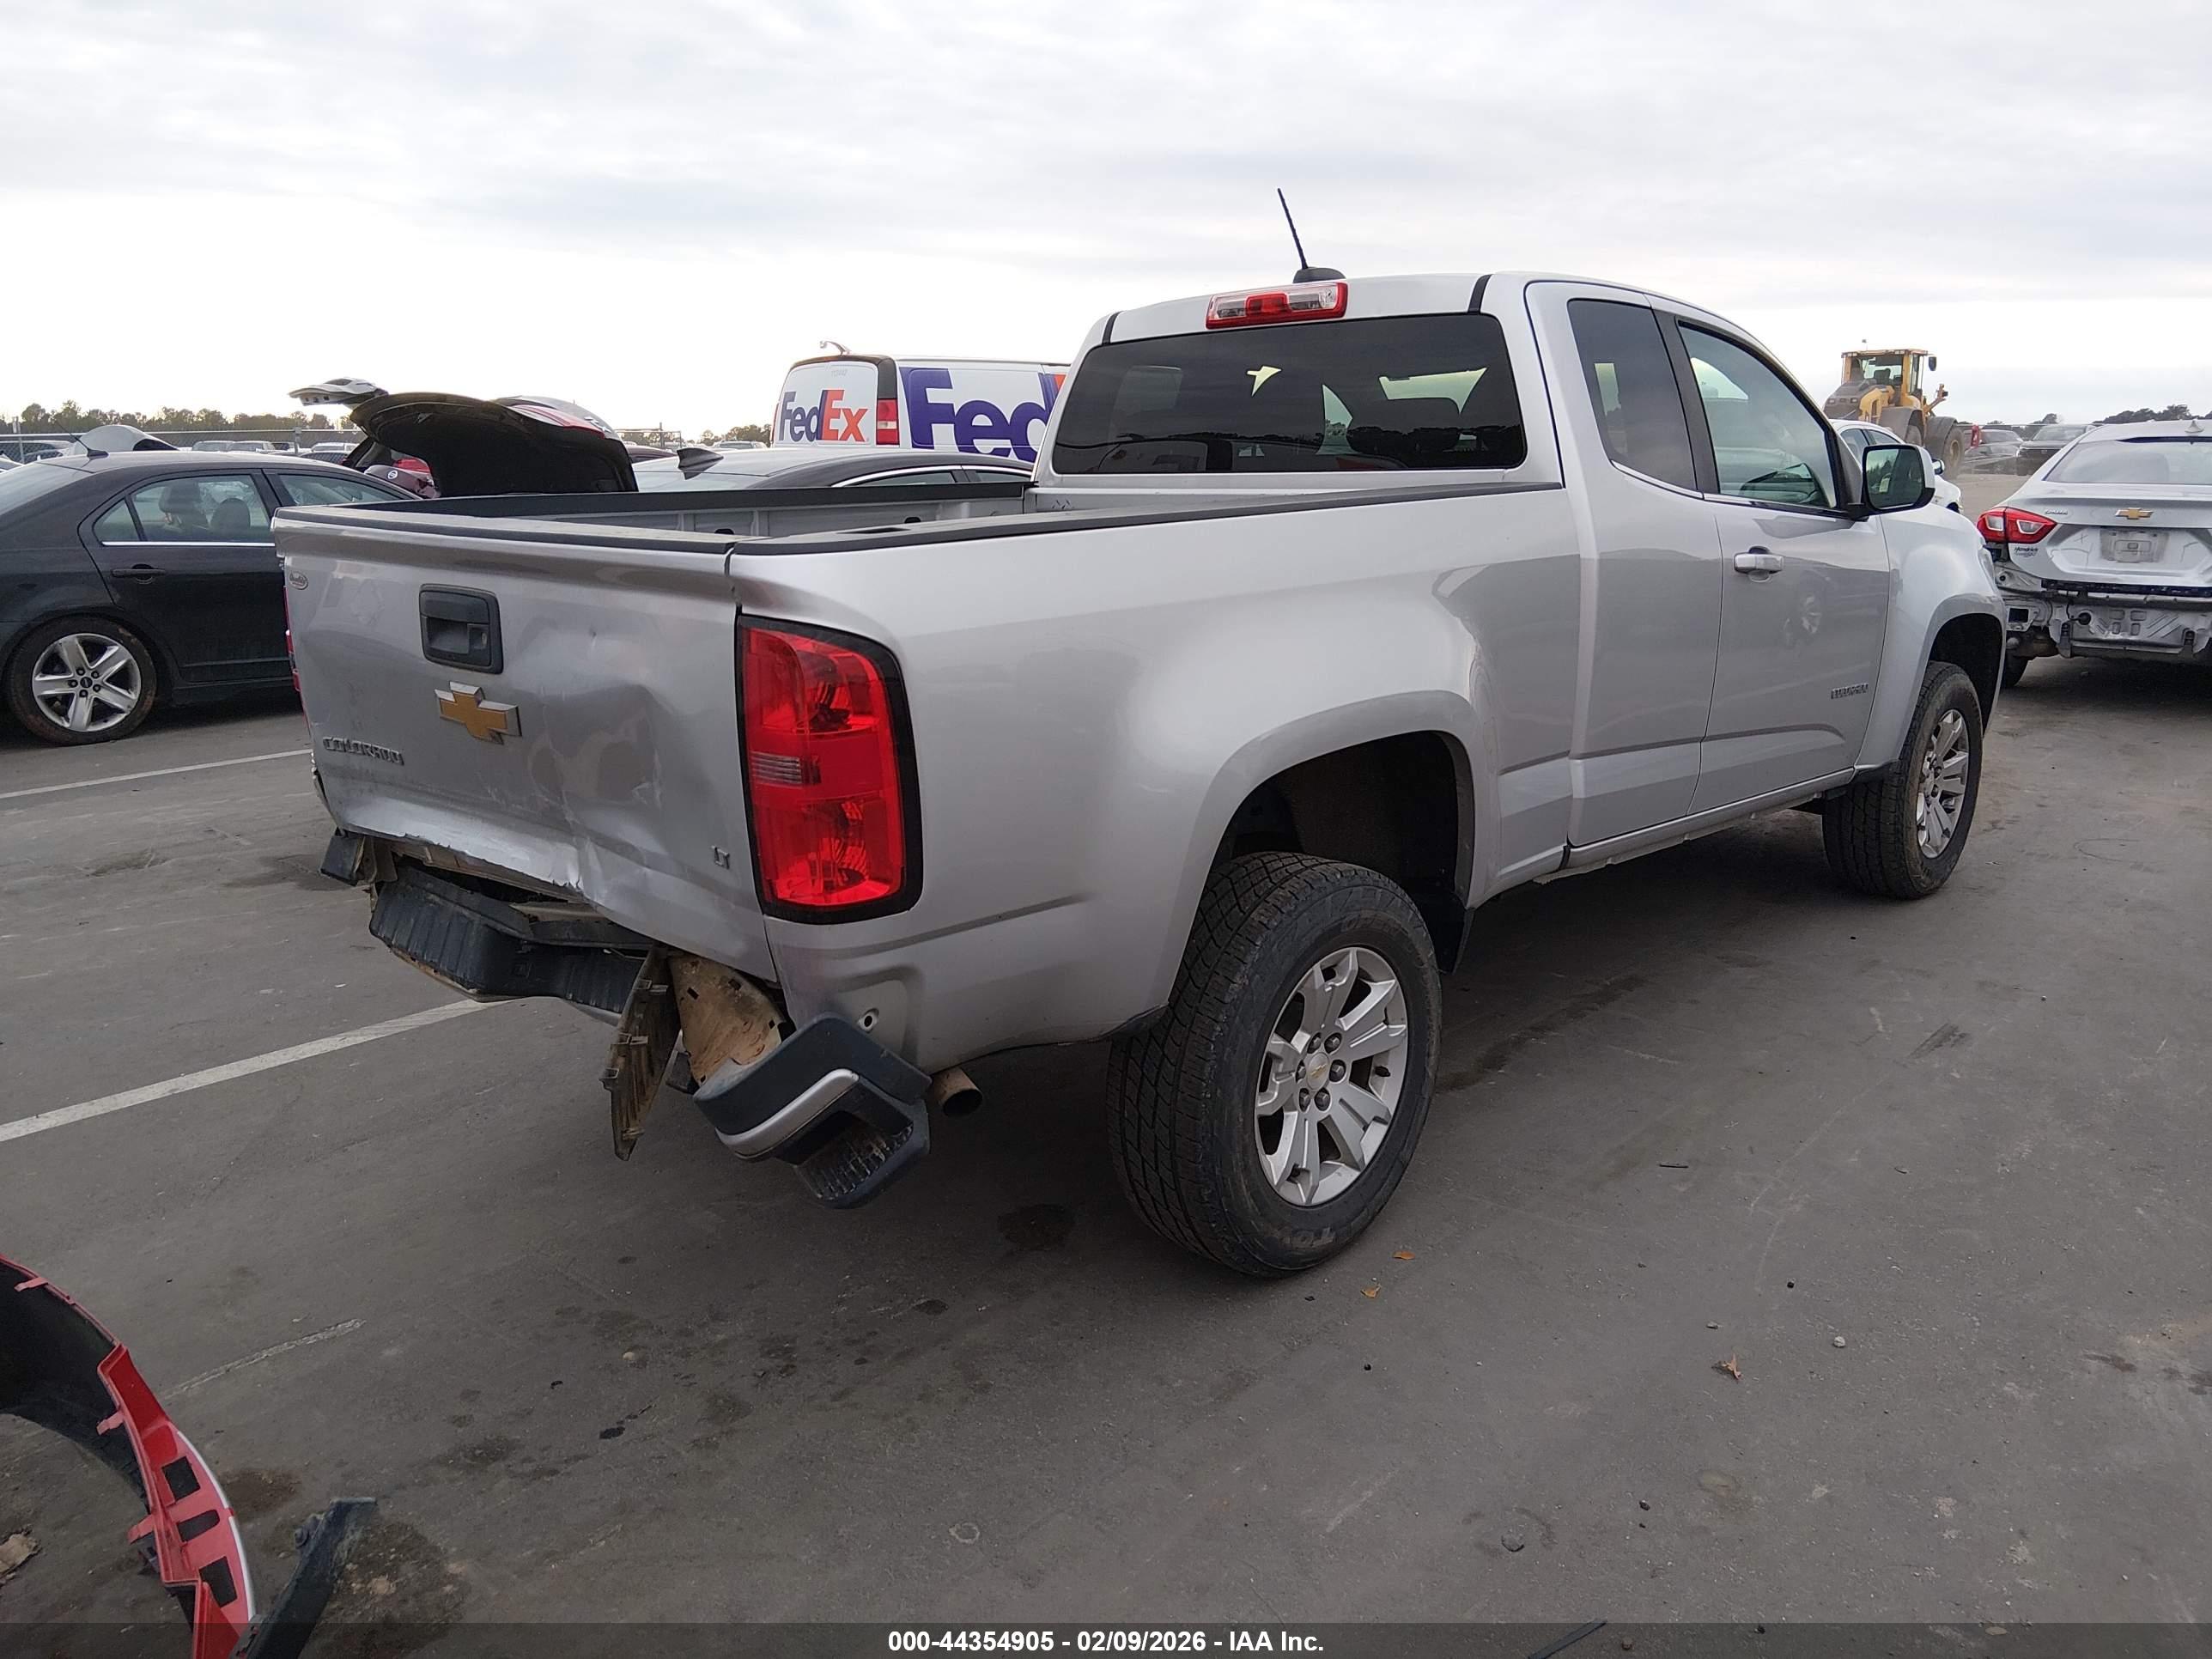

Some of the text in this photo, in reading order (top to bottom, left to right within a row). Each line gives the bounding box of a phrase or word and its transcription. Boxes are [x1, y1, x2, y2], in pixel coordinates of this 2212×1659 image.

[778, 389, 868, 442] FedEx
[899, 367, 1066, 463] Fed
[323, 736, 404, 766] COLORADO
